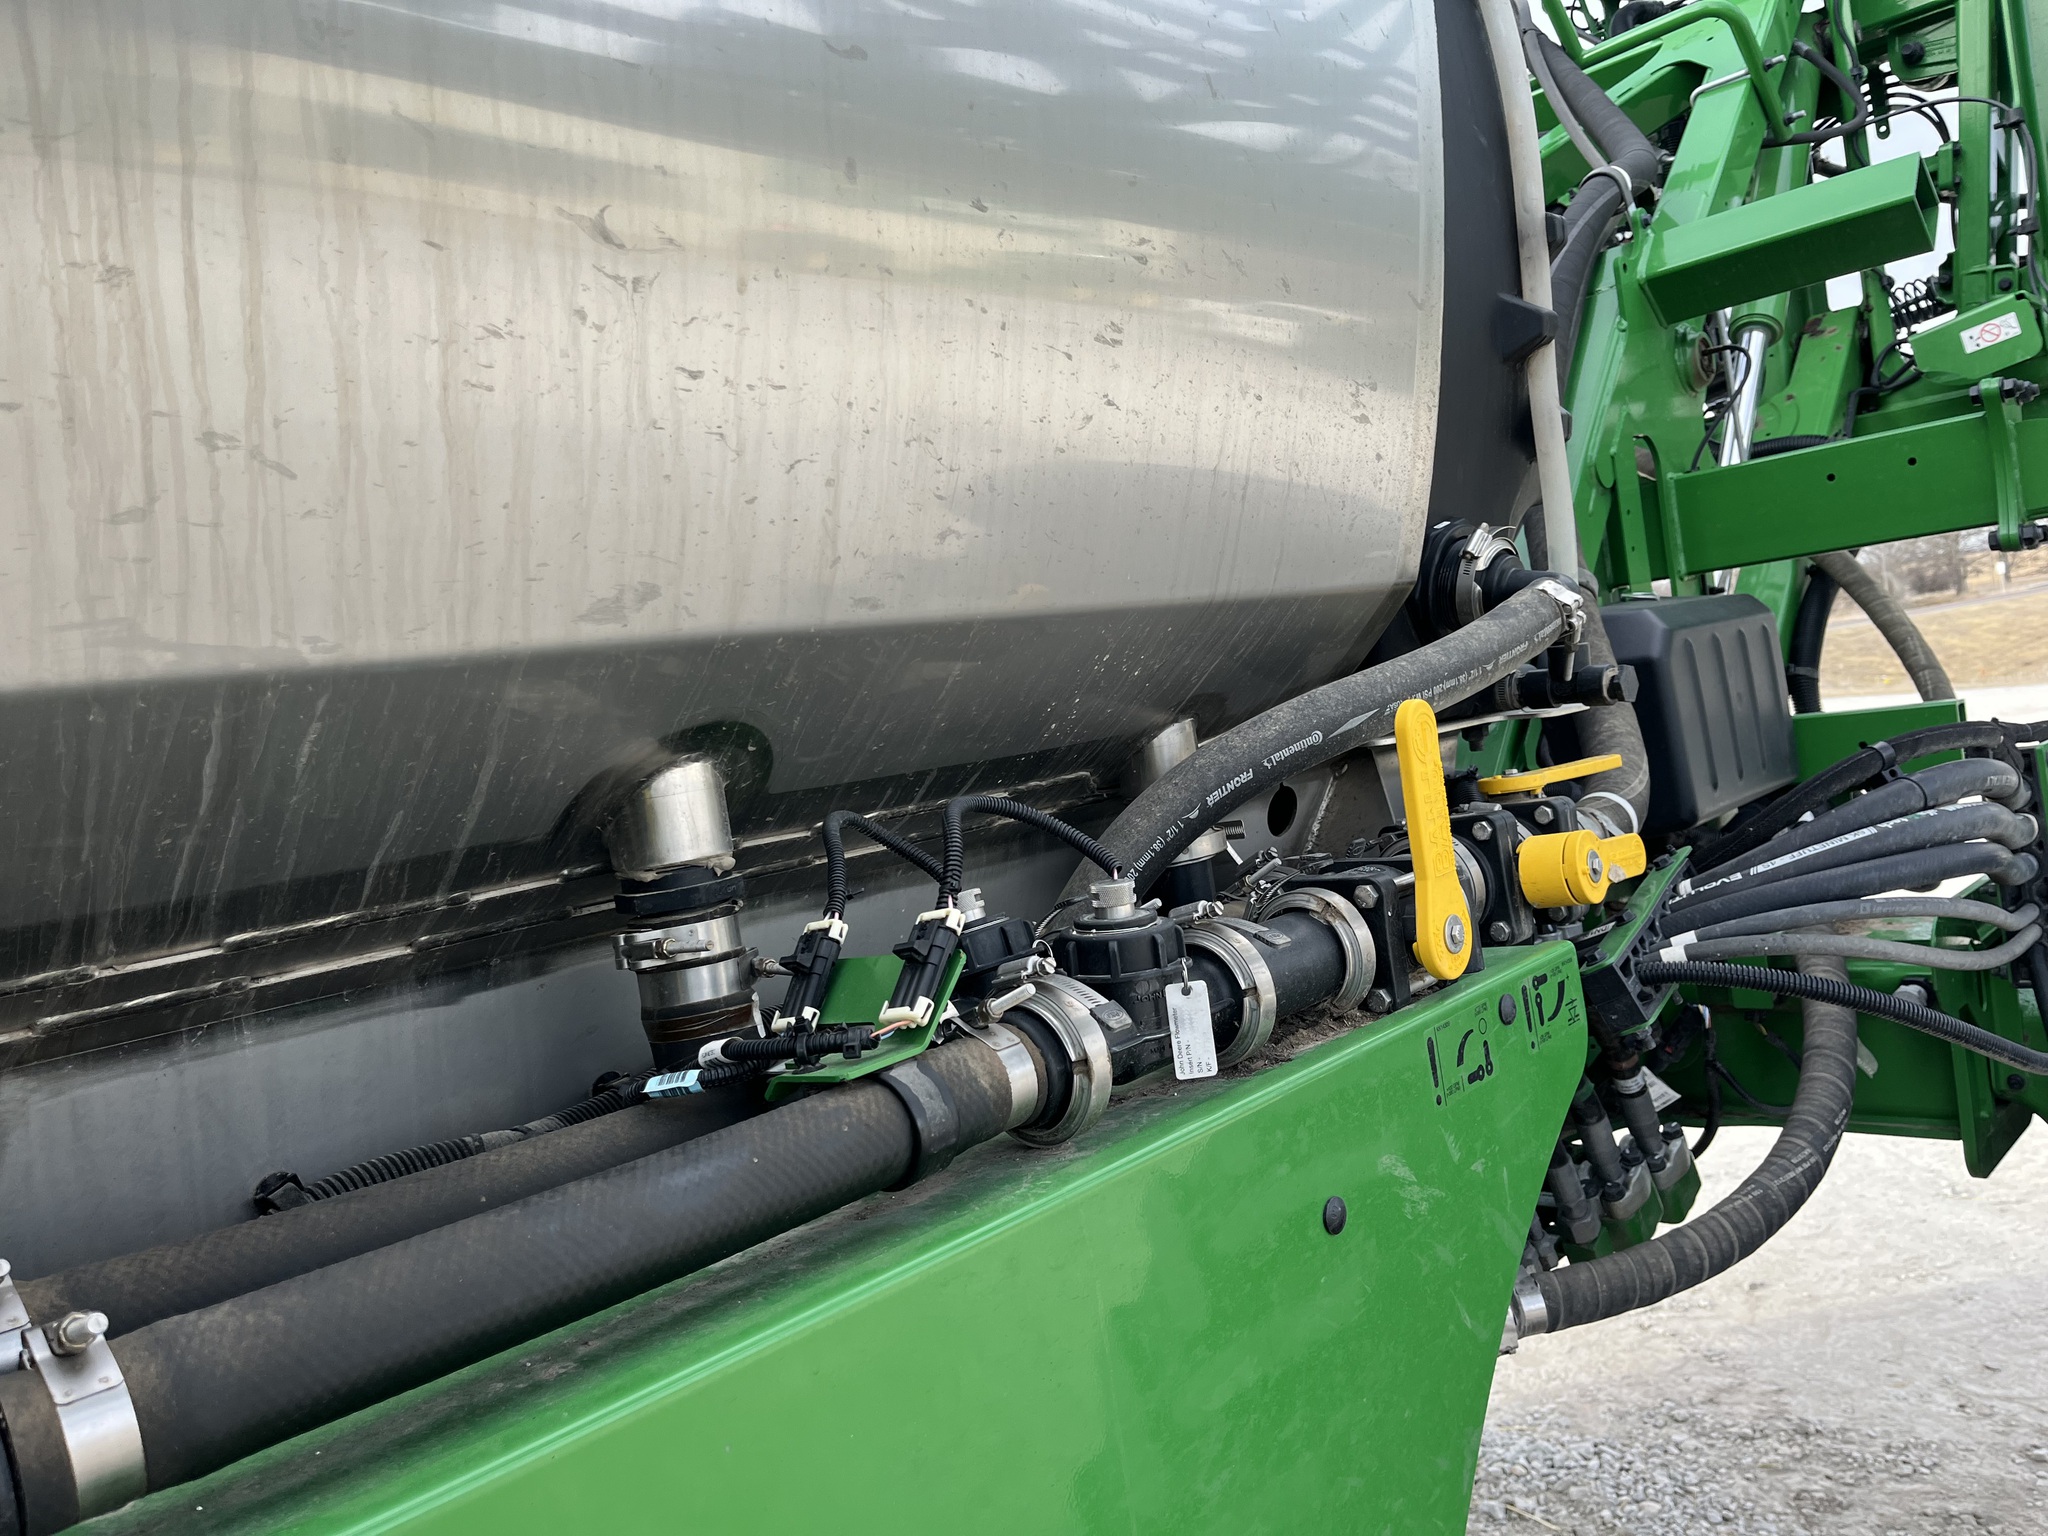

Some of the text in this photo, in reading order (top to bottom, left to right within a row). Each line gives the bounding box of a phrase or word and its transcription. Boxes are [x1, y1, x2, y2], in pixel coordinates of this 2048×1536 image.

[1422, 688, 1432, 699] PSI
[1272, 730, 1323, 766] Continental
[1206, 768, 1254, 807] FRONTIER
[1177, 820, 1184, 829] 1
[1133, 836, 1166, 871] (38.1mm)
[1172, 1007, 1180, 1040] Flowmeter
